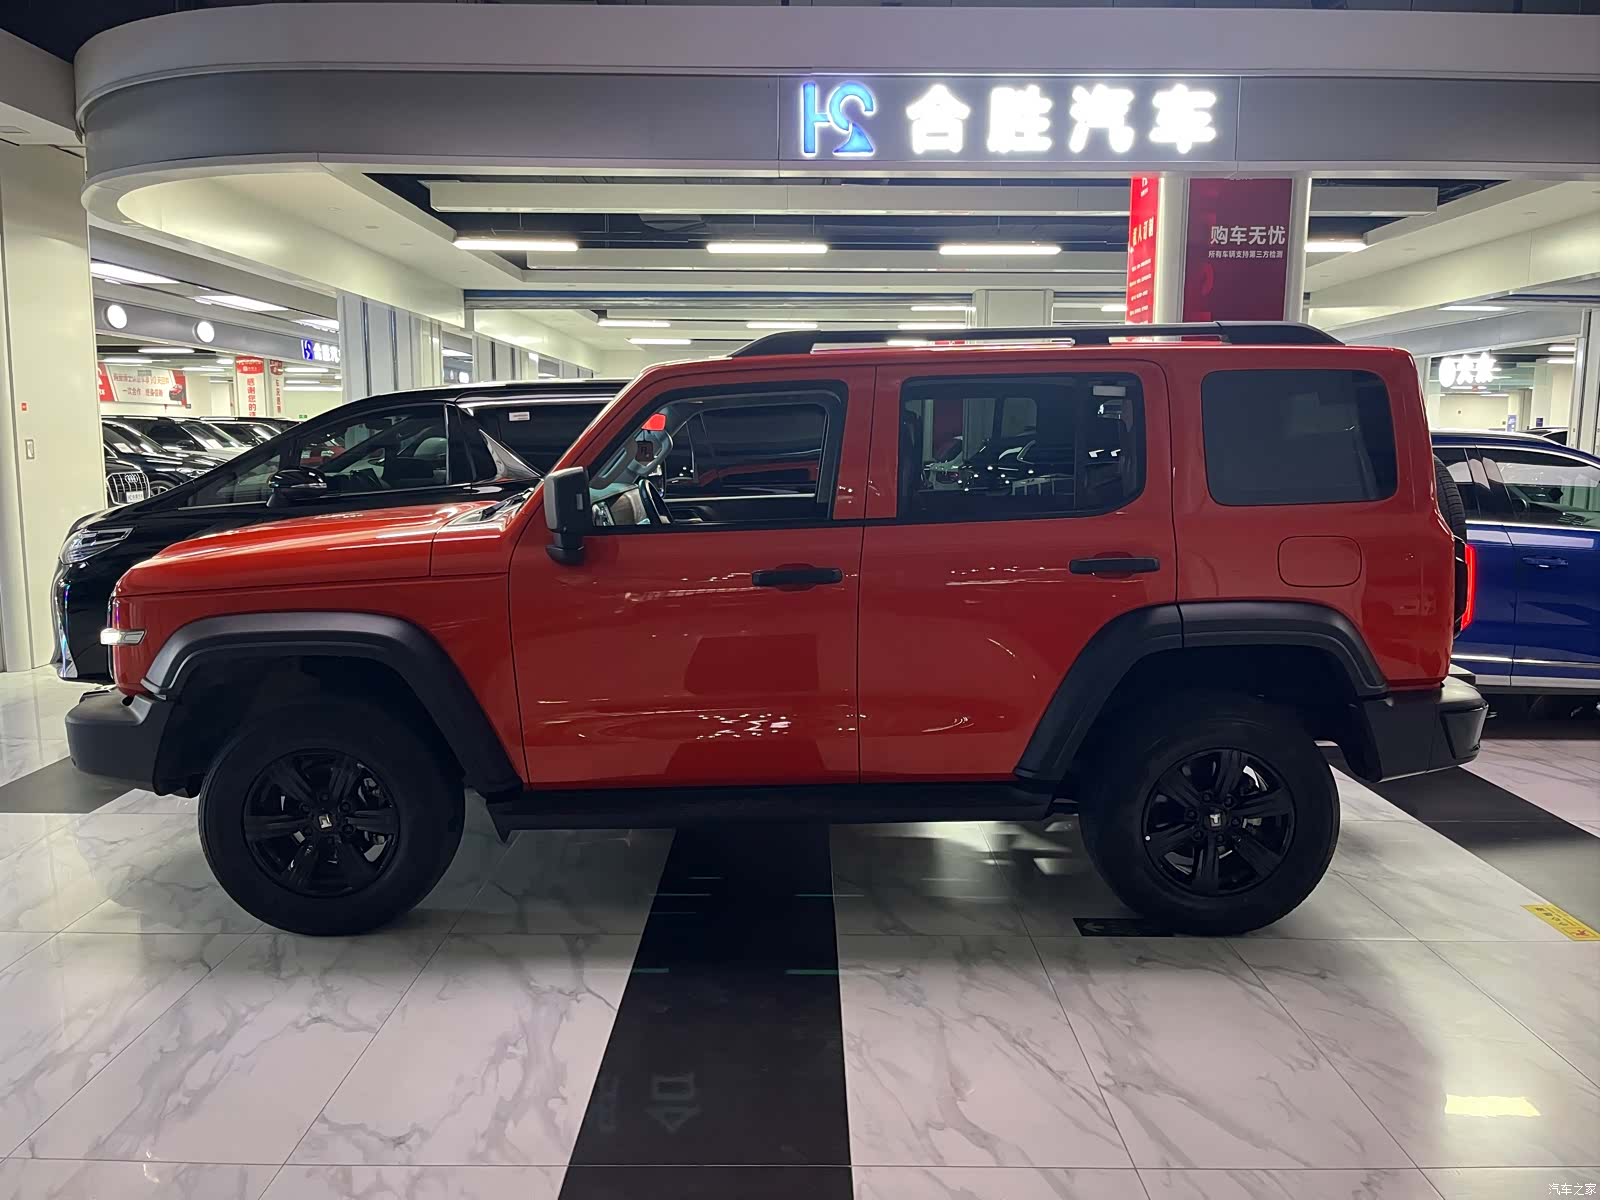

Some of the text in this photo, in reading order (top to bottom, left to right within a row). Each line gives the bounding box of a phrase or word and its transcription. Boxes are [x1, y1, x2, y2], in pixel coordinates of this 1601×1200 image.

[906, 82, 1217, 155] 合胜汽车
[1210, 225, 1286, 245] 购车无忧
[1208, 250, 1283, 259] 所有车辆支持第三方检测
